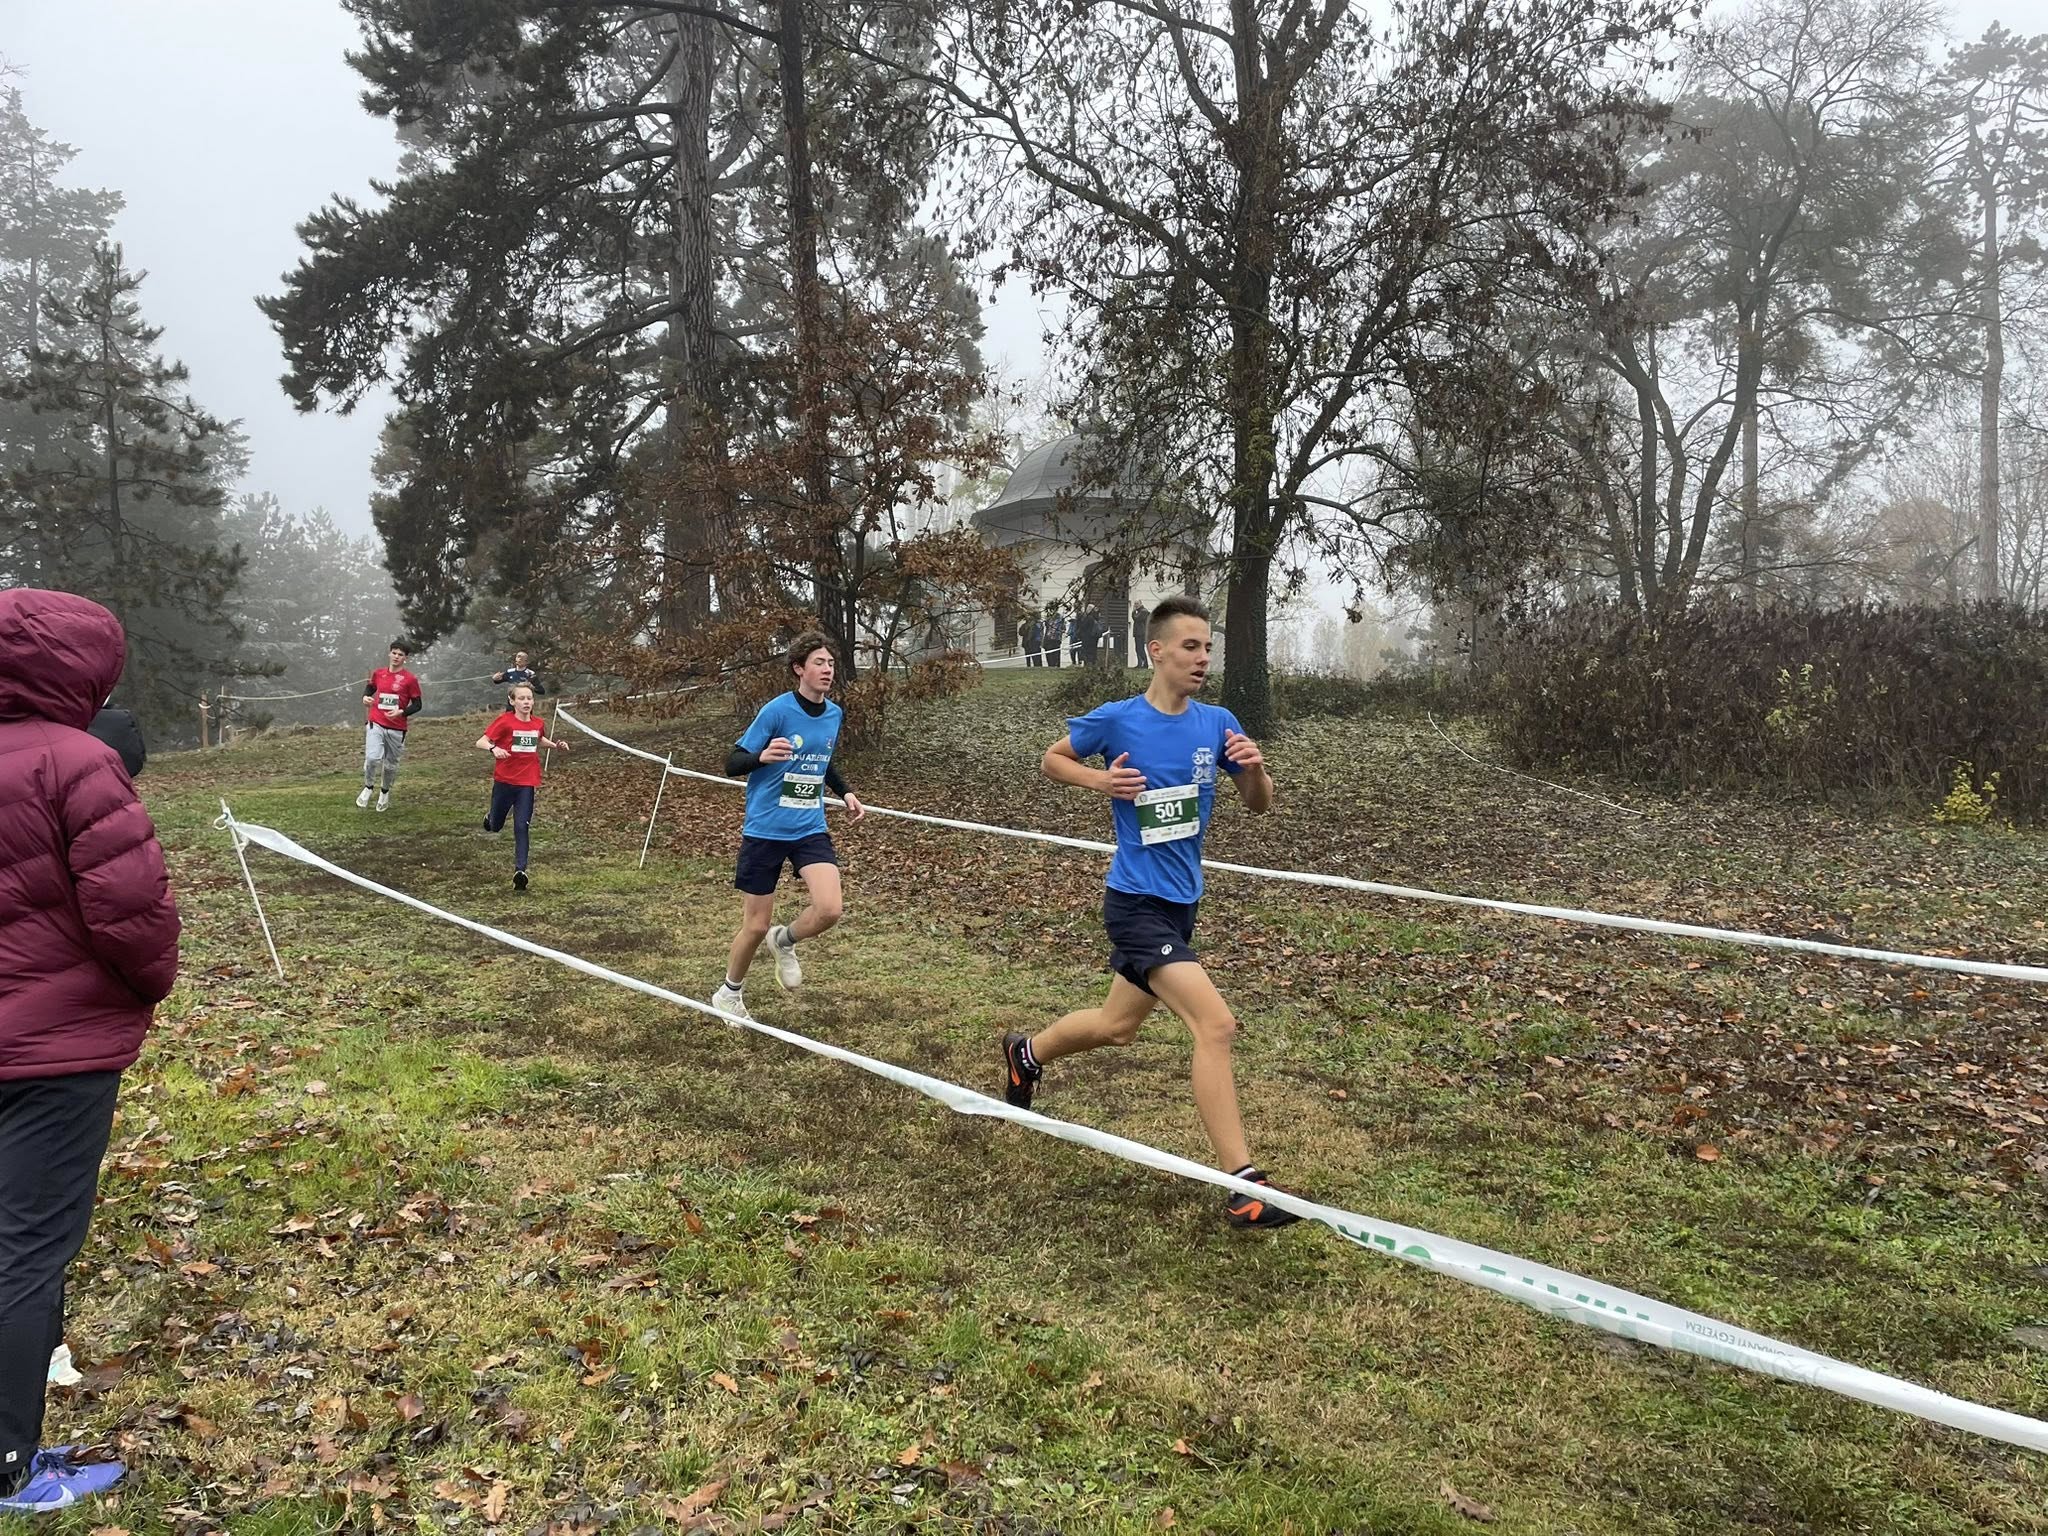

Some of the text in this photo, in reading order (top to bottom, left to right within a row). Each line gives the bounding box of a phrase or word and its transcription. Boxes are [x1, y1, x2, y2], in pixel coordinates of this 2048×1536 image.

[520, 736, 533, 746] 531
[794, 784, 815, 795] 522
[1154, 800, 1184, 820] 501
[1685, 1320, 1736, 1344] EGYETEM
